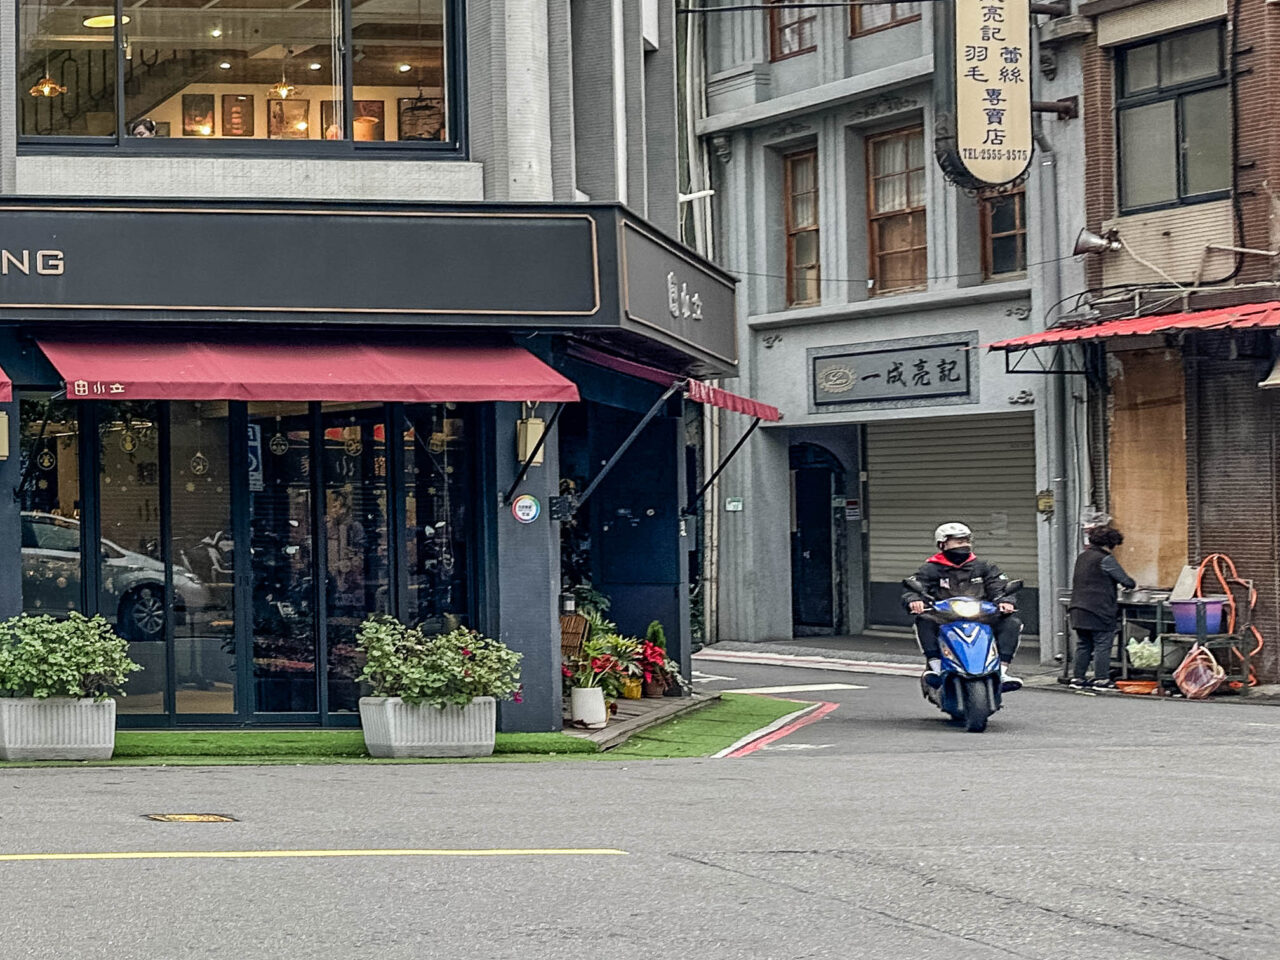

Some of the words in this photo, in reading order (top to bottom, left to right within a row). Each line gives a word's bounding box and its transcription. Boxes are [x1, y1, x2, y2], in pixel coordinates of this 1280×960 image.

[964, 45, 989, 83] 羽毛
[999, 46, 1024, 84] 蕾絲
[981, 88, 1007, 146] 專賣店
[861, 358, 961, 387] 一成亮記
